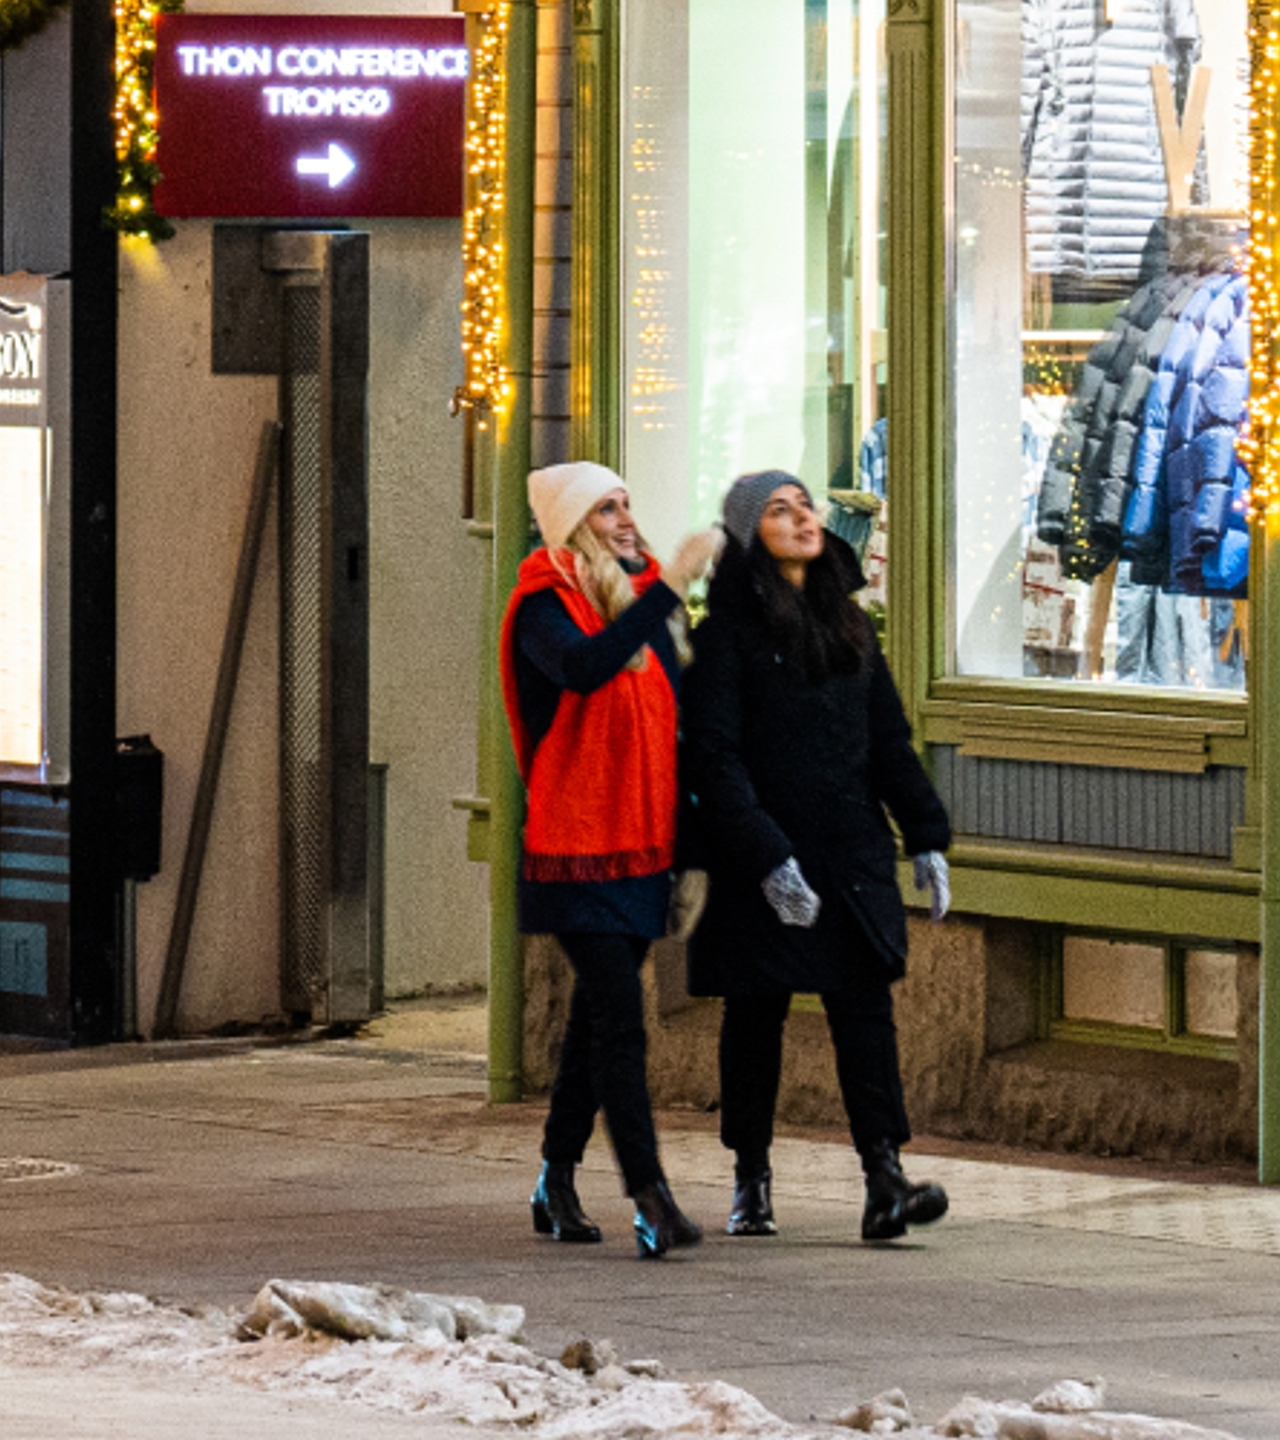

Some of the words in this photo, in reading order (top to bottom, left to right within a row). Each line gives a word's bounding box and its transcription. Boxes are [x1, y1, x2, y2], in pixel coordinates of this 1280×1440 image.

[177, 46, 270, 76] THON
[276, 46, 468, 78] CONFERENCE
[263, 86, 390, 116] TROMSØ
